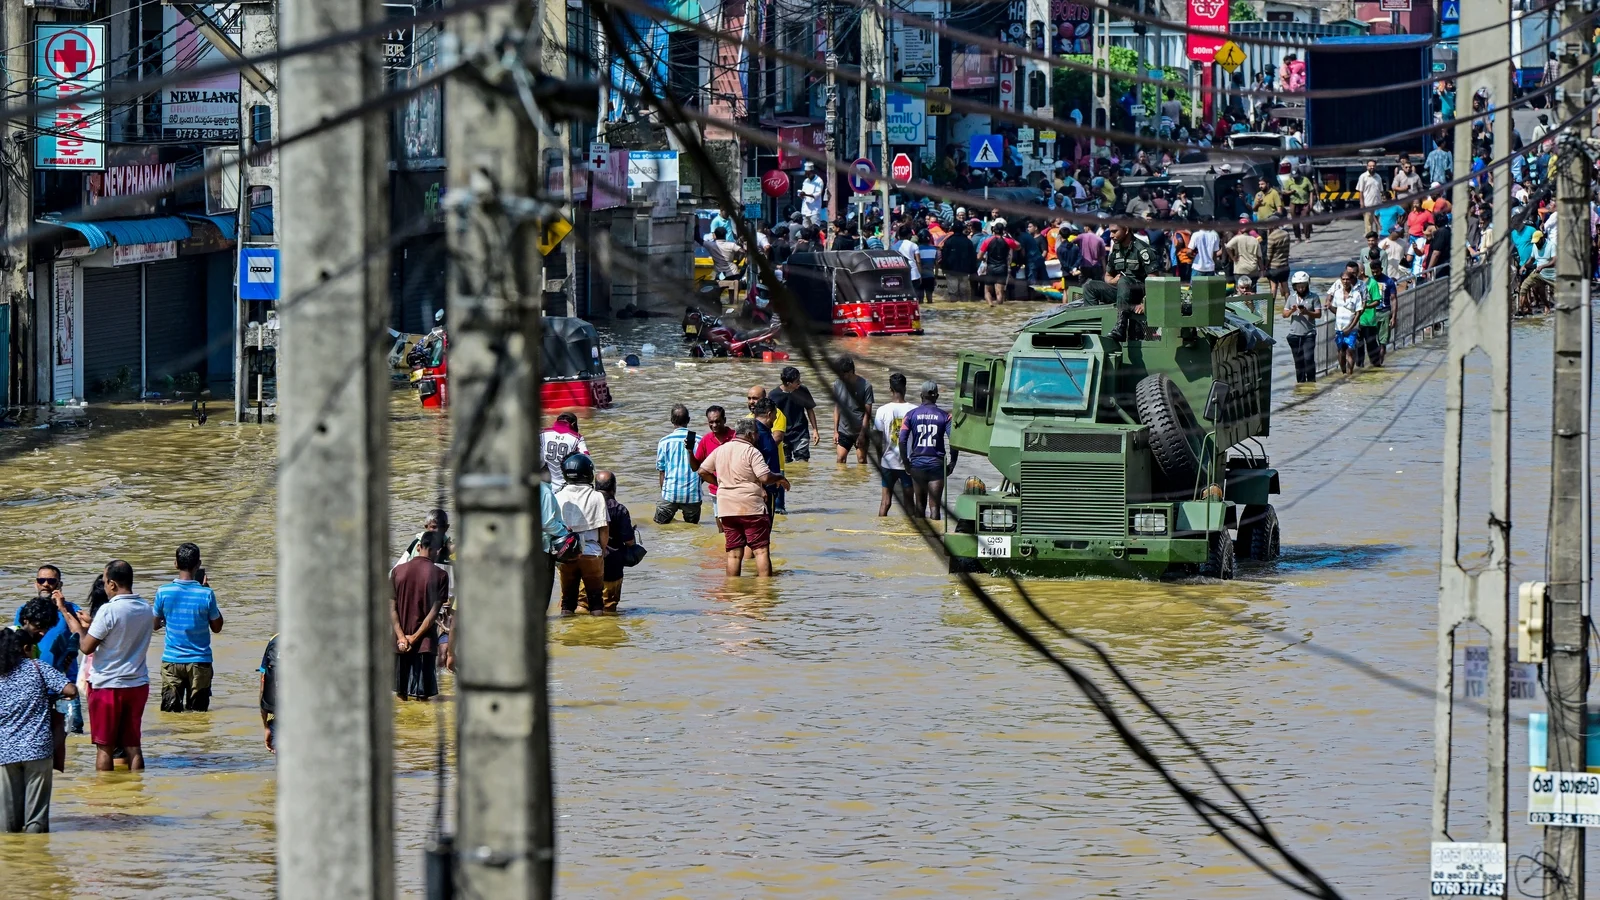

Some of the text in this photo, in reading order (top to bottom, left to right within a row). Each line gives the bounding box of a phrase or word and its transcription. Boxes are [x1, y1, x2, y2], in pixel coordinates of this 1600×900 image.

[170, 91, 200, 103] NEW
[170, 104, 208, 113] DRIVING
[176, 129, 199, 139] 0773
[201, 129, 219, 139] 209
[894, 165, 910, 176] STOP
[104, 162, 176, 197] NEW PHARMACY
[872, 256, 906, 269] YEMEN
[917, 424, 938, 447] 22
[546, 440, 569, 461] 99
[980, 547, 1007, 556] 44101
[1531, 812, 1551, 822] 070
[1432, 881, 1504, 896] 0760 377 543
